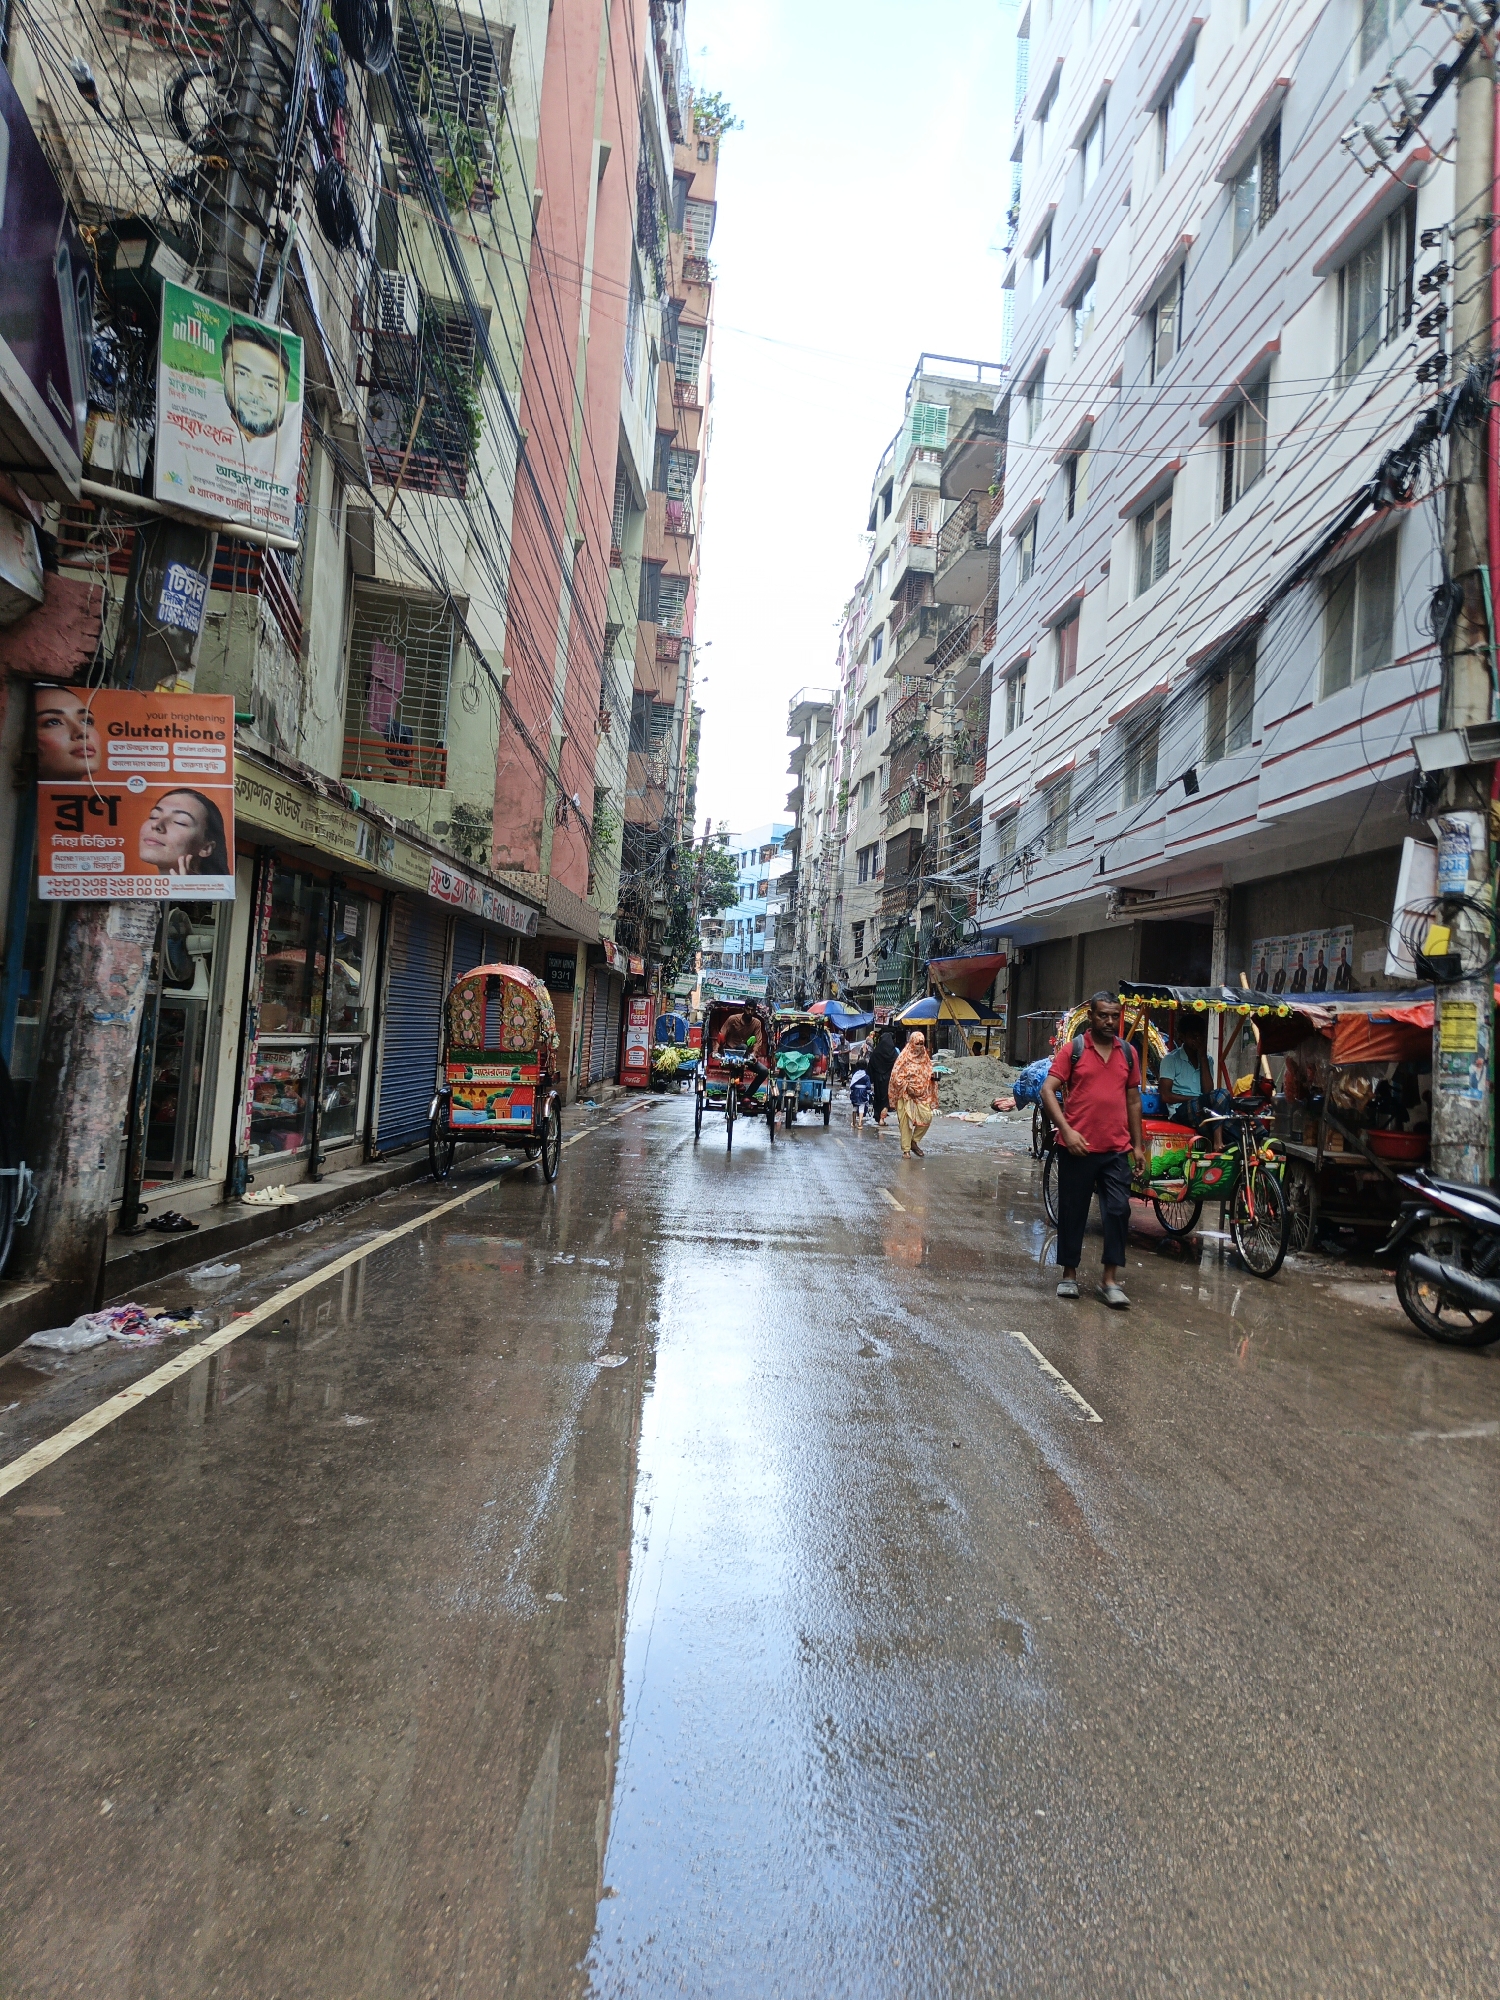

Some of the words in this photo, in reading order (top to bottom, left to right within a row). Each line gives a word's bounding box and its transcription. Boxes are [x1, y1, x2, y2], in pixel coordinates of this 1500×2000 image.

[216, 464, 252, 485] আব্দুল
[254, 476, 290, 497] খালেক
[197, 487, 224, 502] খালেক
[168, 564, 206, 603] টিচার
[146, 712, 168, 720] your
[171, 712, 226, 724] brightening
[107, 721, 226, 740] Glutathione
[50, 794, 121, 832] ব্রণ
[274, 790, 302, 823] হাউজ
[51, 835, 77, 847] নিয়ে
[492, 897, 510, 927] Food
[551, 970, 570, 980] 93/1
